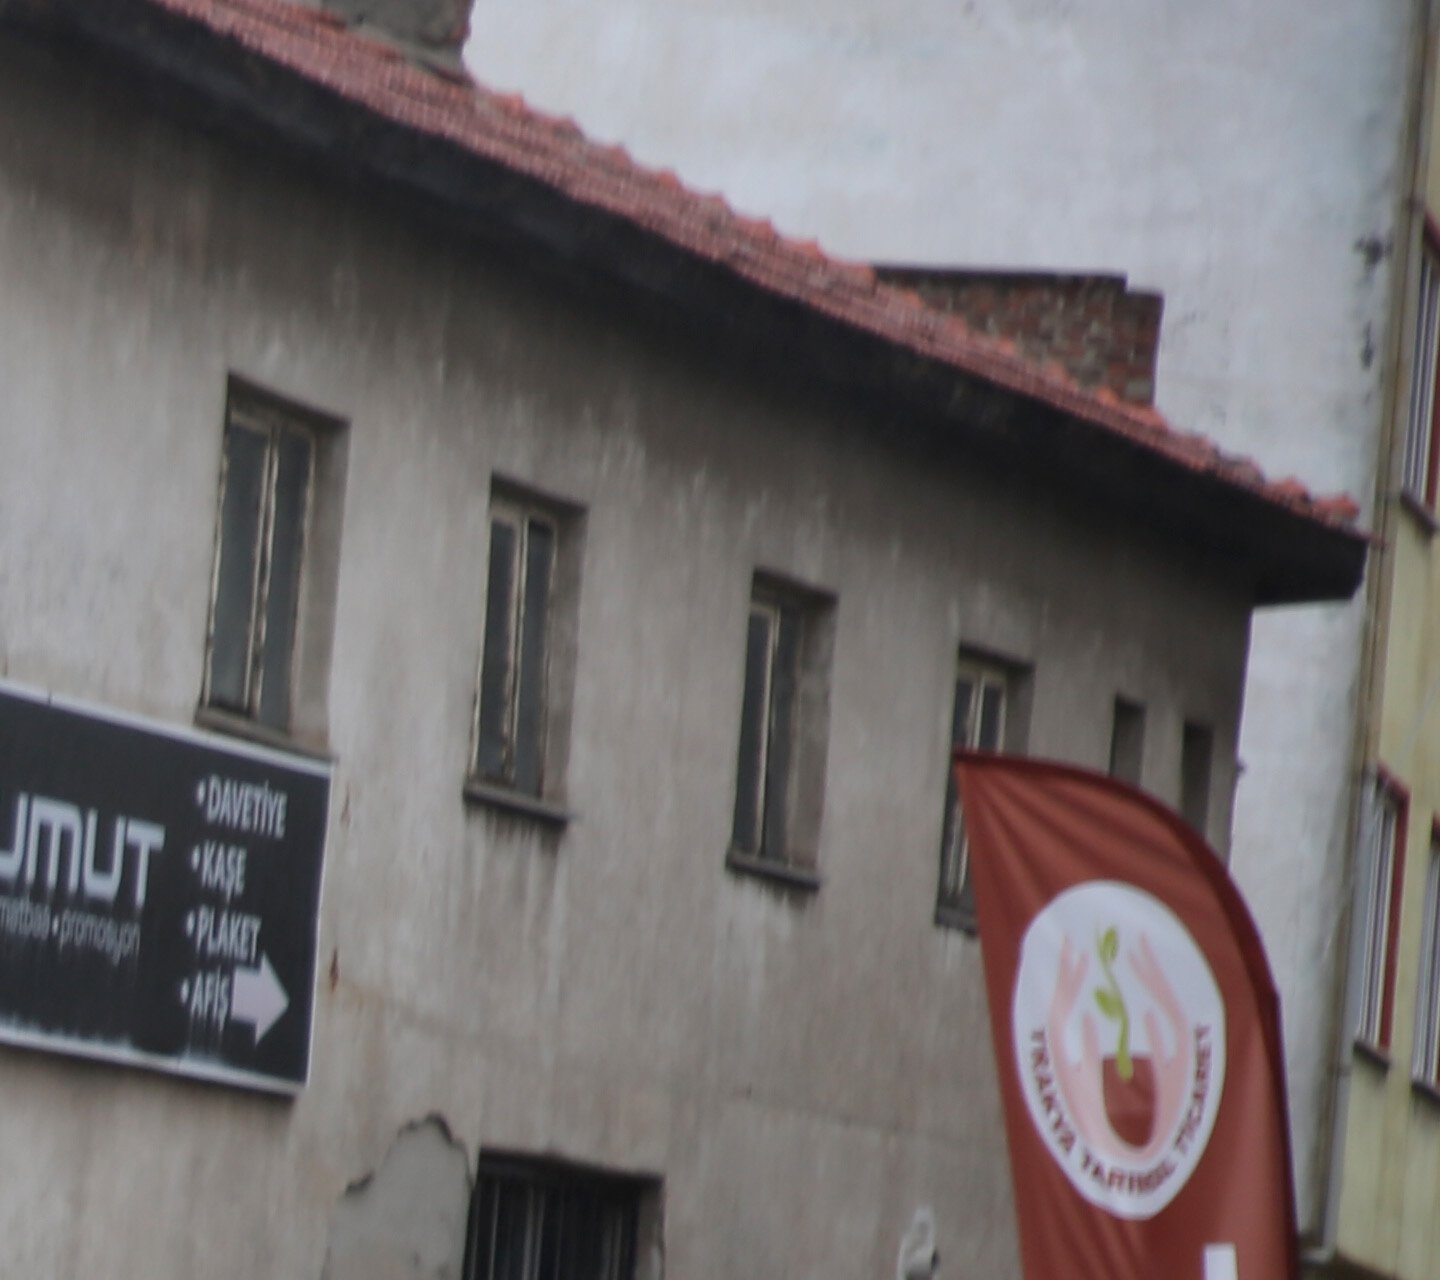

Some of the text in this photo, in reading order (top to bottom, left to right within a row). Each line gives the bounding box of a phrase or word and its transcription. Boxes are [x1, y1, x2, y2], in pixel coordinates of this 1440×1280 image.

[207, 773, 289, 841] DAVETİYE
[201, 839, 247, 901] KAŞE
[196, 904, 261, 962] PLAKET
[190, 967, 230, 1029] AFİŞ
